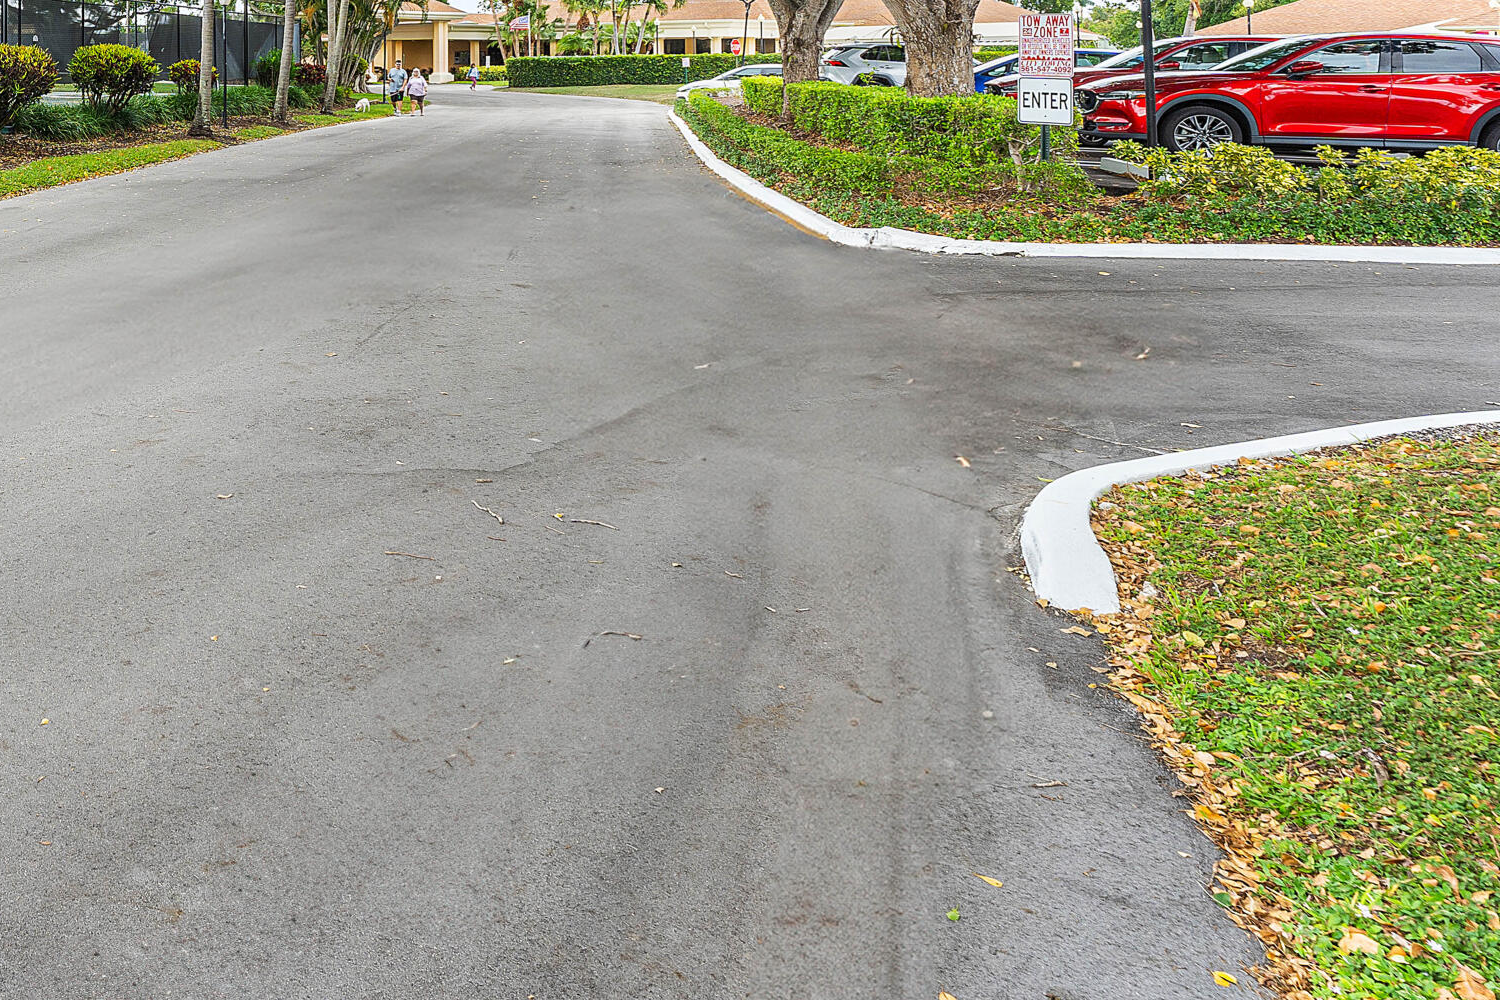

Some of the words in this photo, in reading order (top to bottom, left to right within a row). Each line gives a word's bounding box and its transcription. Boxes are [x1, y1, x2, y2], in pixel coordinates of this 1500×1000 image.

[1022, 15, 1040, 27] TOW
[1045, 15, 1070, 27] AWAY
[1033, 27, 1058, 38] ZONE
[1022, 91, 1068, 110] ENTER
